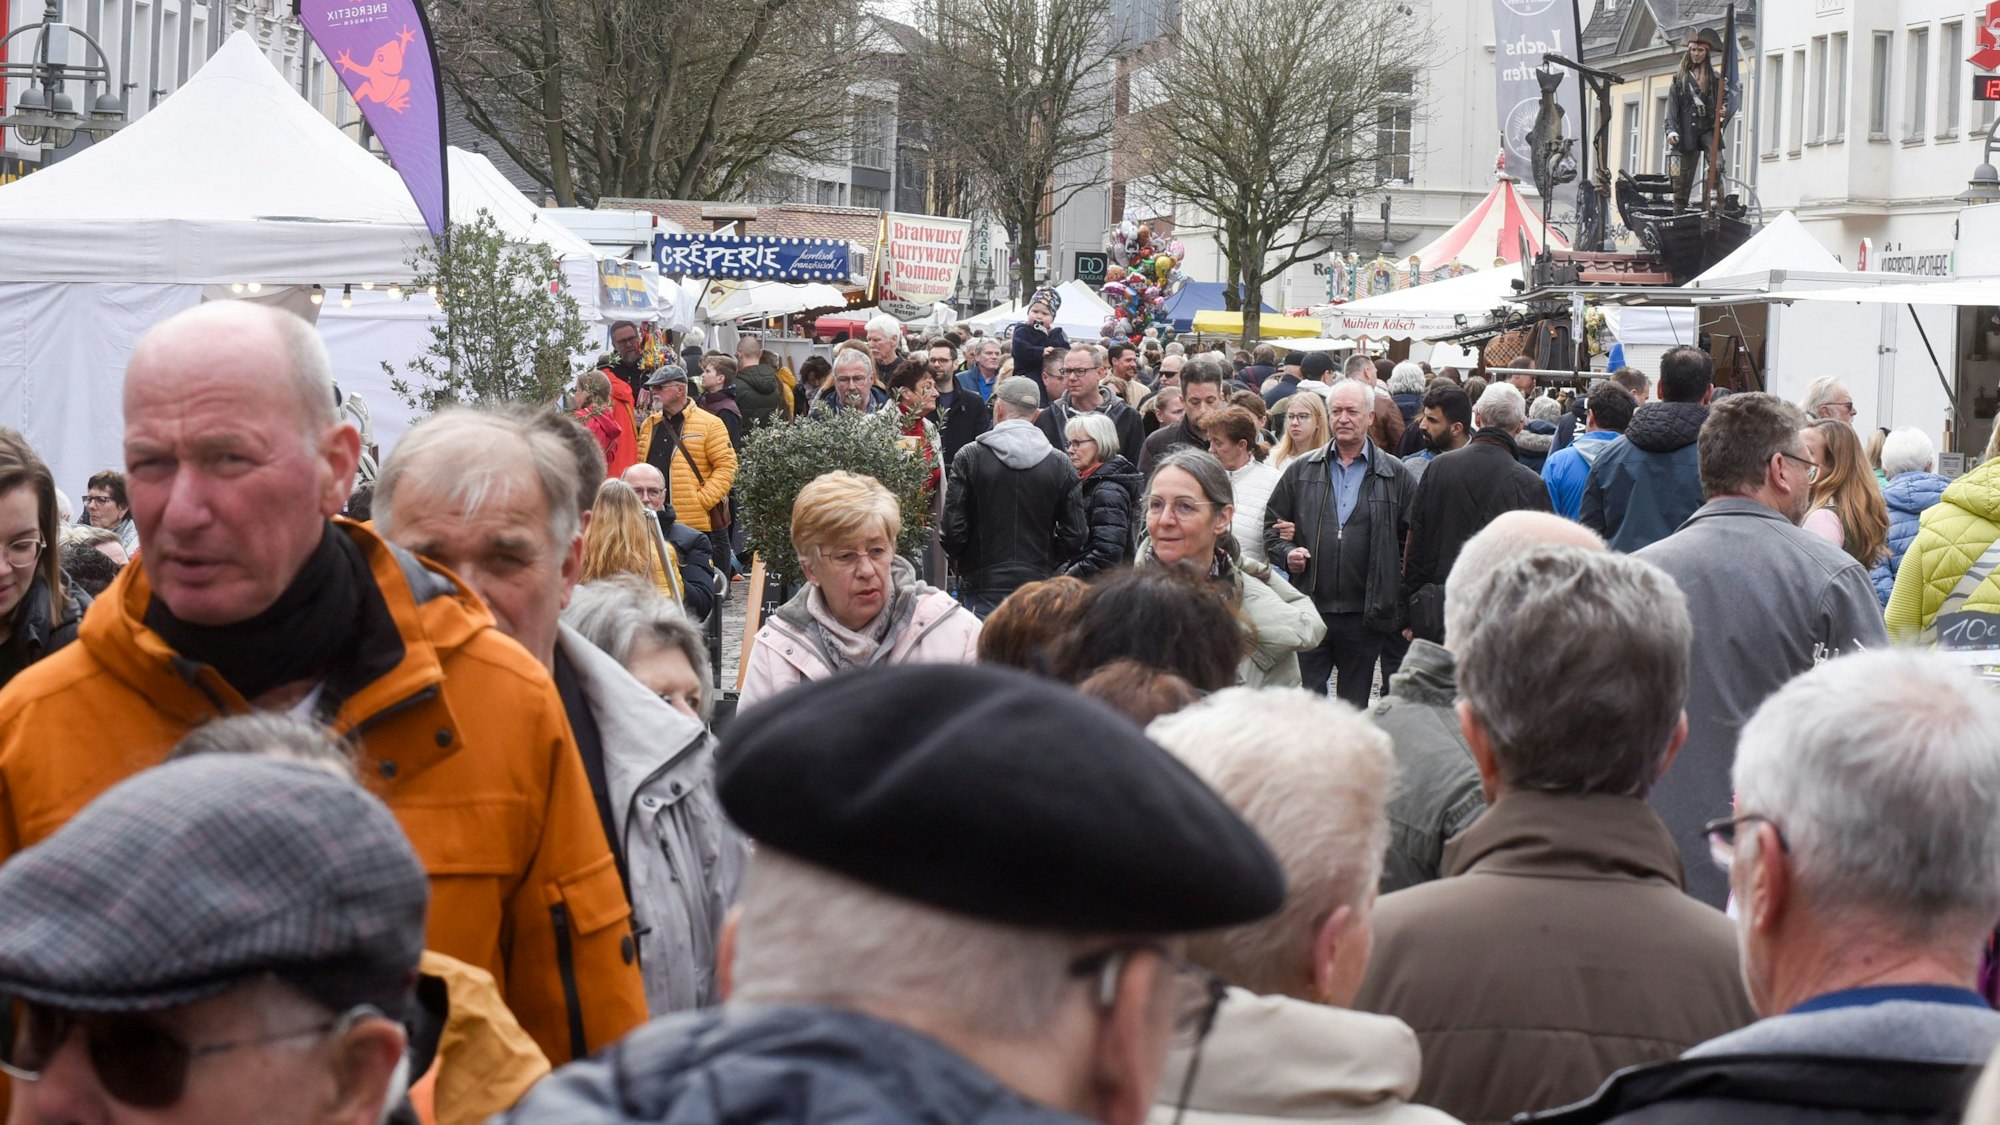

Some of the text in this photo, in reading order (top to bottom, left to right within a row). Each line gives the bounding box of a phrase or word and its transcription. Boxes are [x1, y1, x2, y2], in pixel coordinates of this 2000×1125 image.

[894, 222, 963, 245] Bratwurst
[661, 240, 781, 269] CRÊPERIE
[890, 240, 962, 265] Currywurst
[895, 261, 953, 282] Pommes
[1341, 317, 1379, 329] Mühlen
[1382, 318, 1416, 331] Kölsch
[1943, 618, 1997, 641] 10€
